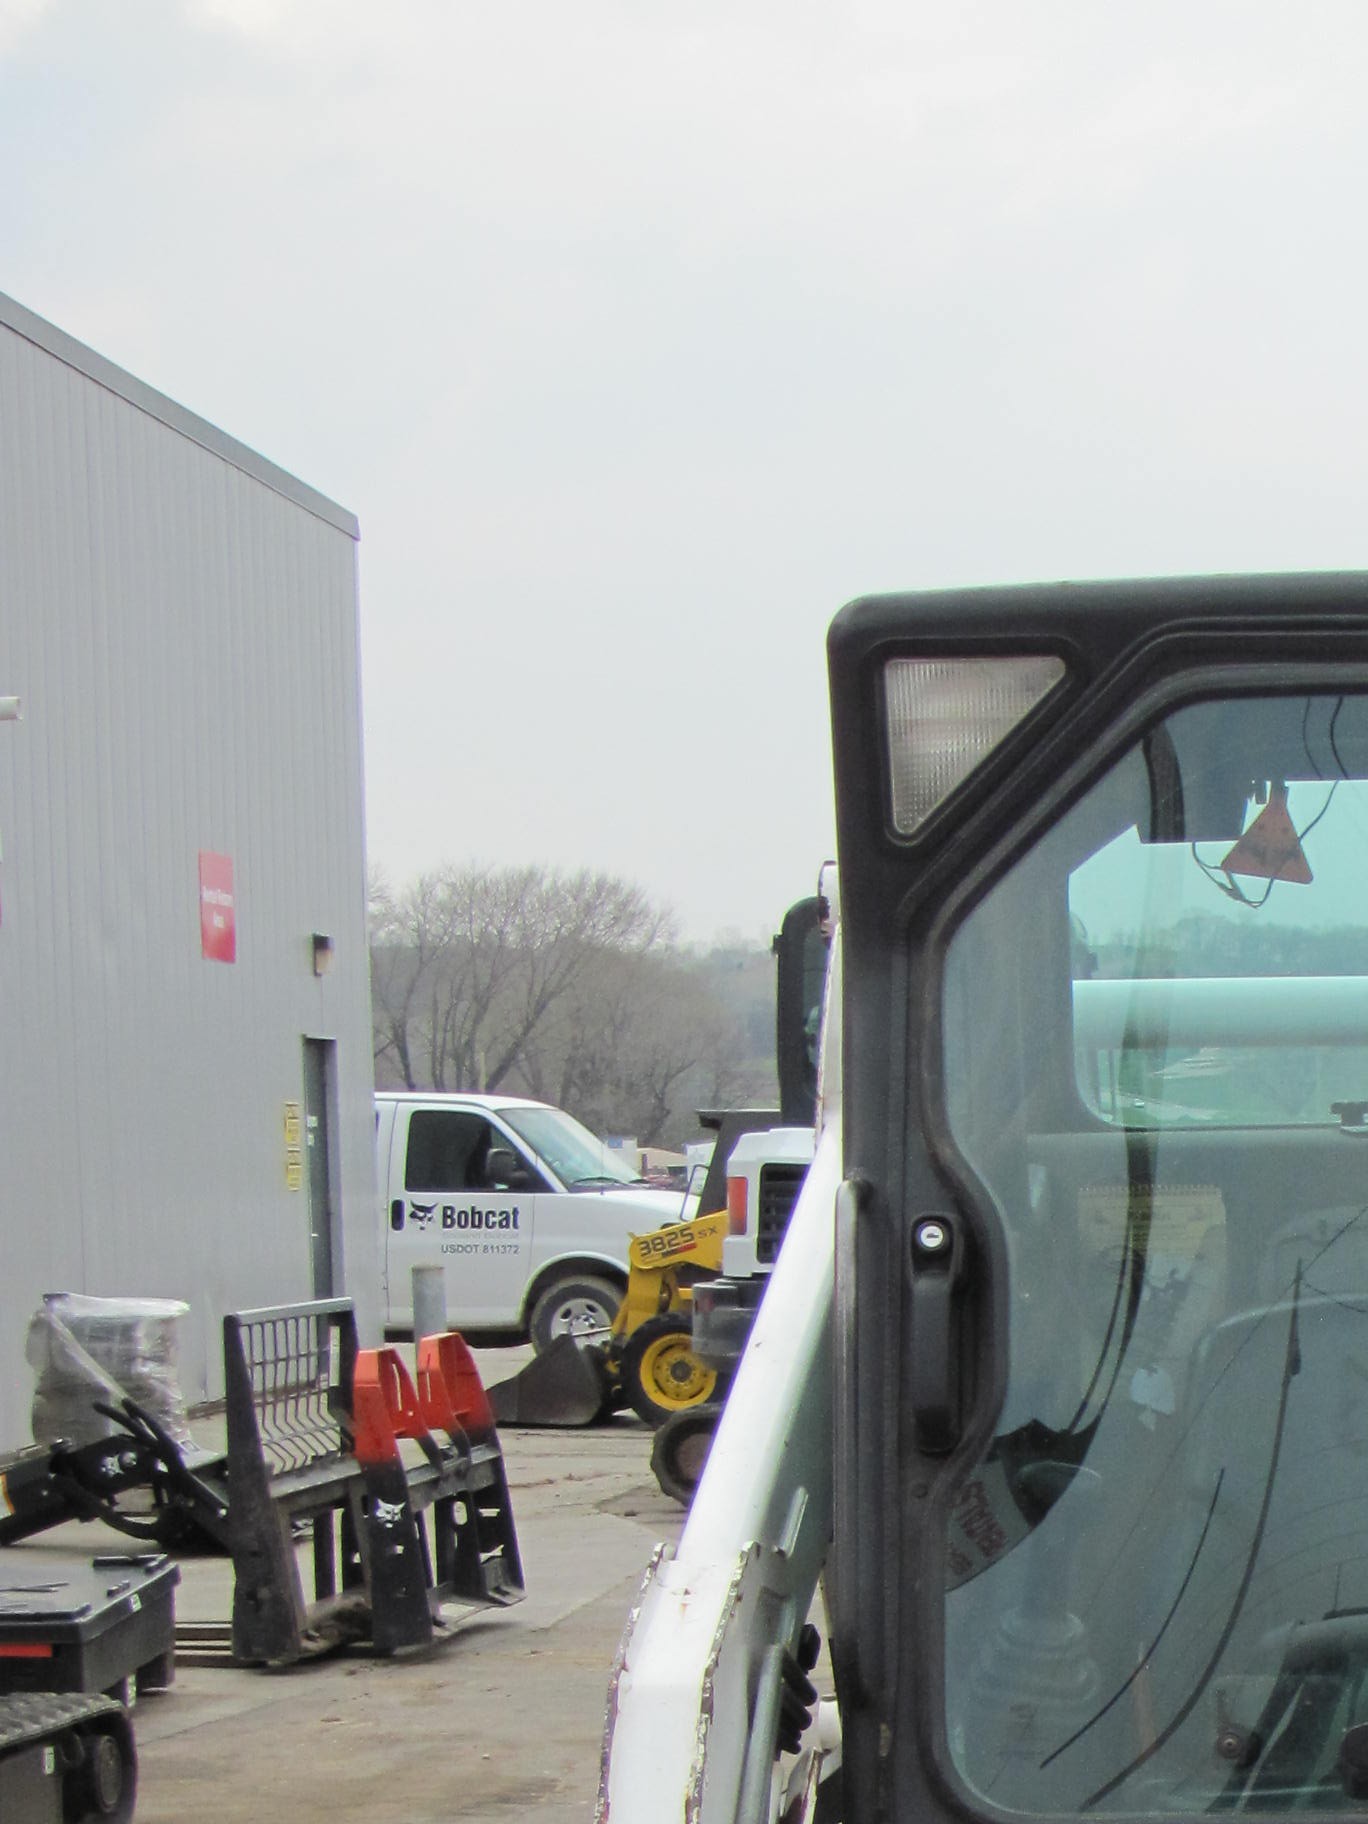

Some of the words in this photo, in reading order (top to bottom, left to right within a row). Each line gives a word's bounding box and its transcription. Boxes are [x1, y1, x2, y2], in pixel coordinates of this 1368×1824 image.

[442, 1205, 519, 1230] Bobcat
[441, 1244, 480, 1254] USDOT
[482, 1244, 520, 1255] 811372
[637, 1226, 695, 1258] 3825
